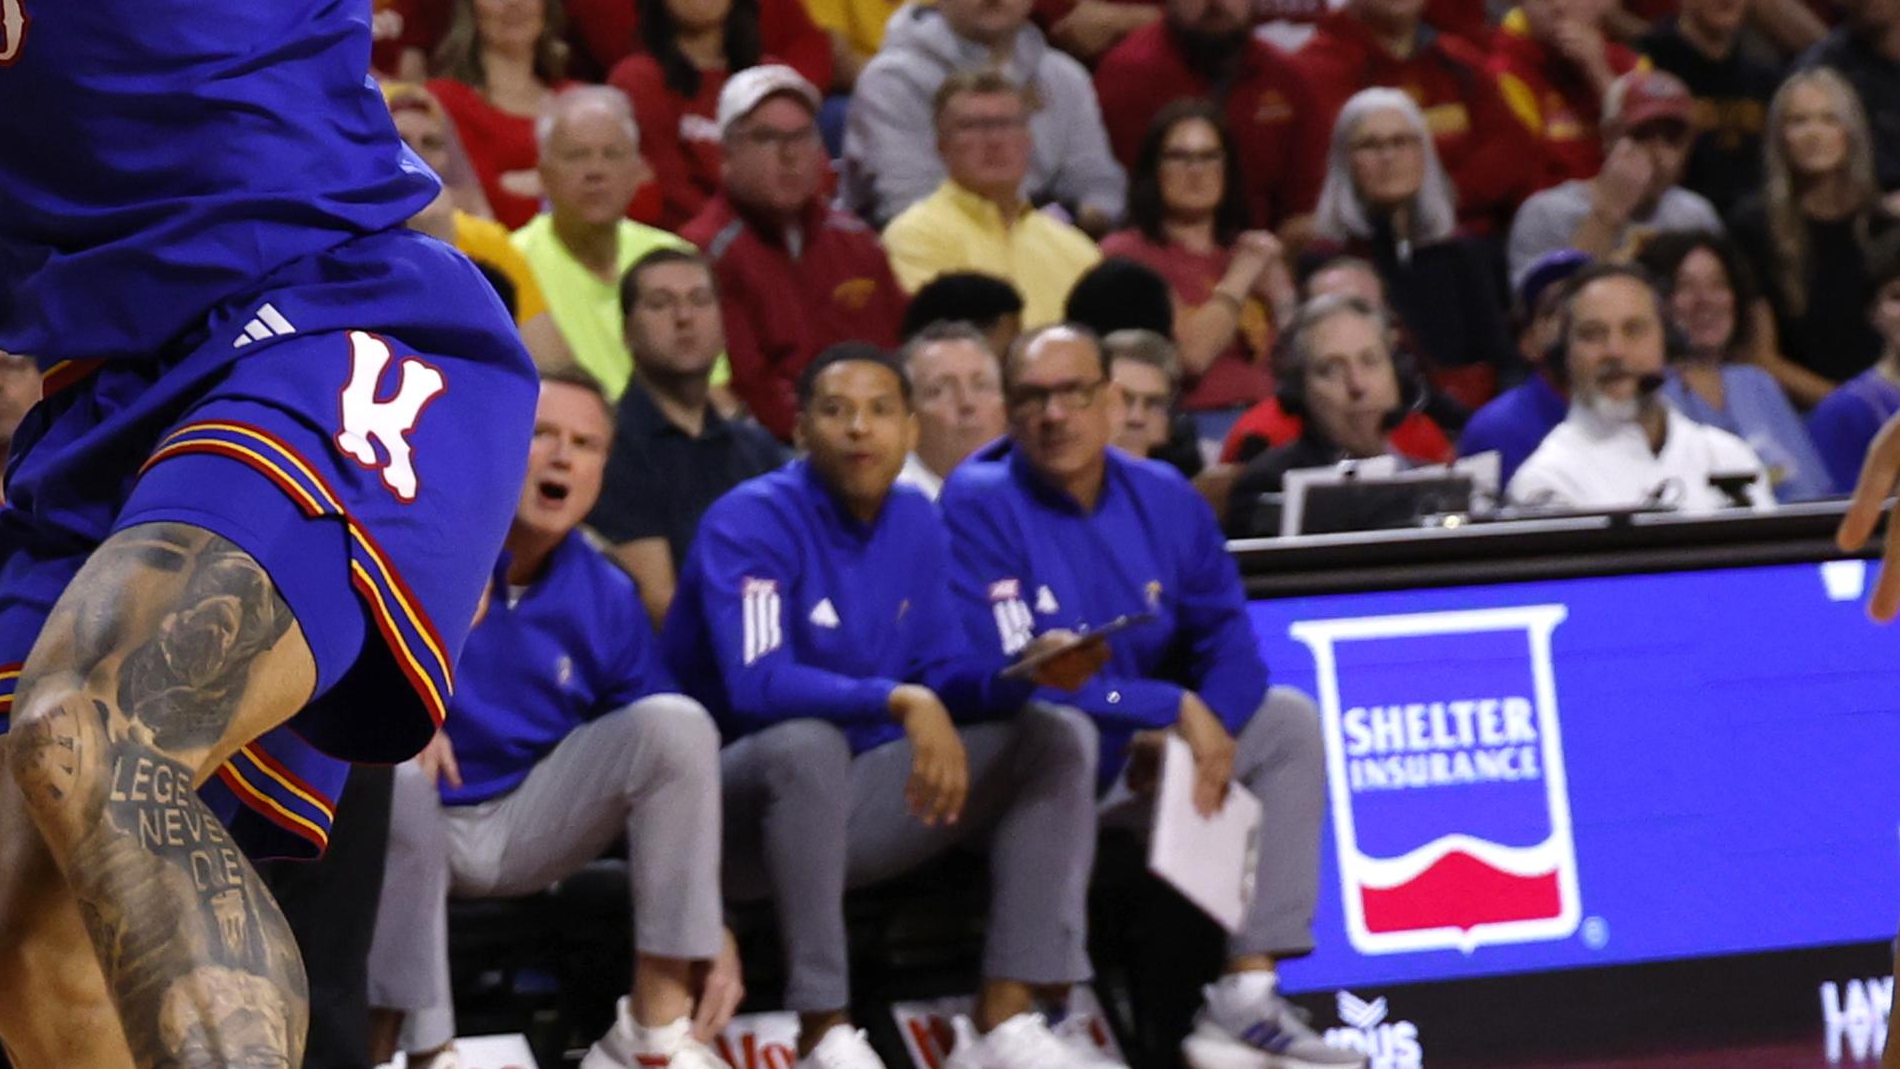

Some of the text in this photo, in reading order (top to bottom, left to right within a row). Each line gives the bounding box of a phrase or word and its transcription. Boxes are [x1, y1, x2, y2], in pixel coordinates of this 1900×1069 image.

[334, 328, 448, 505] K
[1343, 696, 1538, 757] SHELTER
[109, 755, 195, 807] LEGE
[1350, 745, 1541, 793] INSURANCE
[137, 807, 226, 850] NEVE
